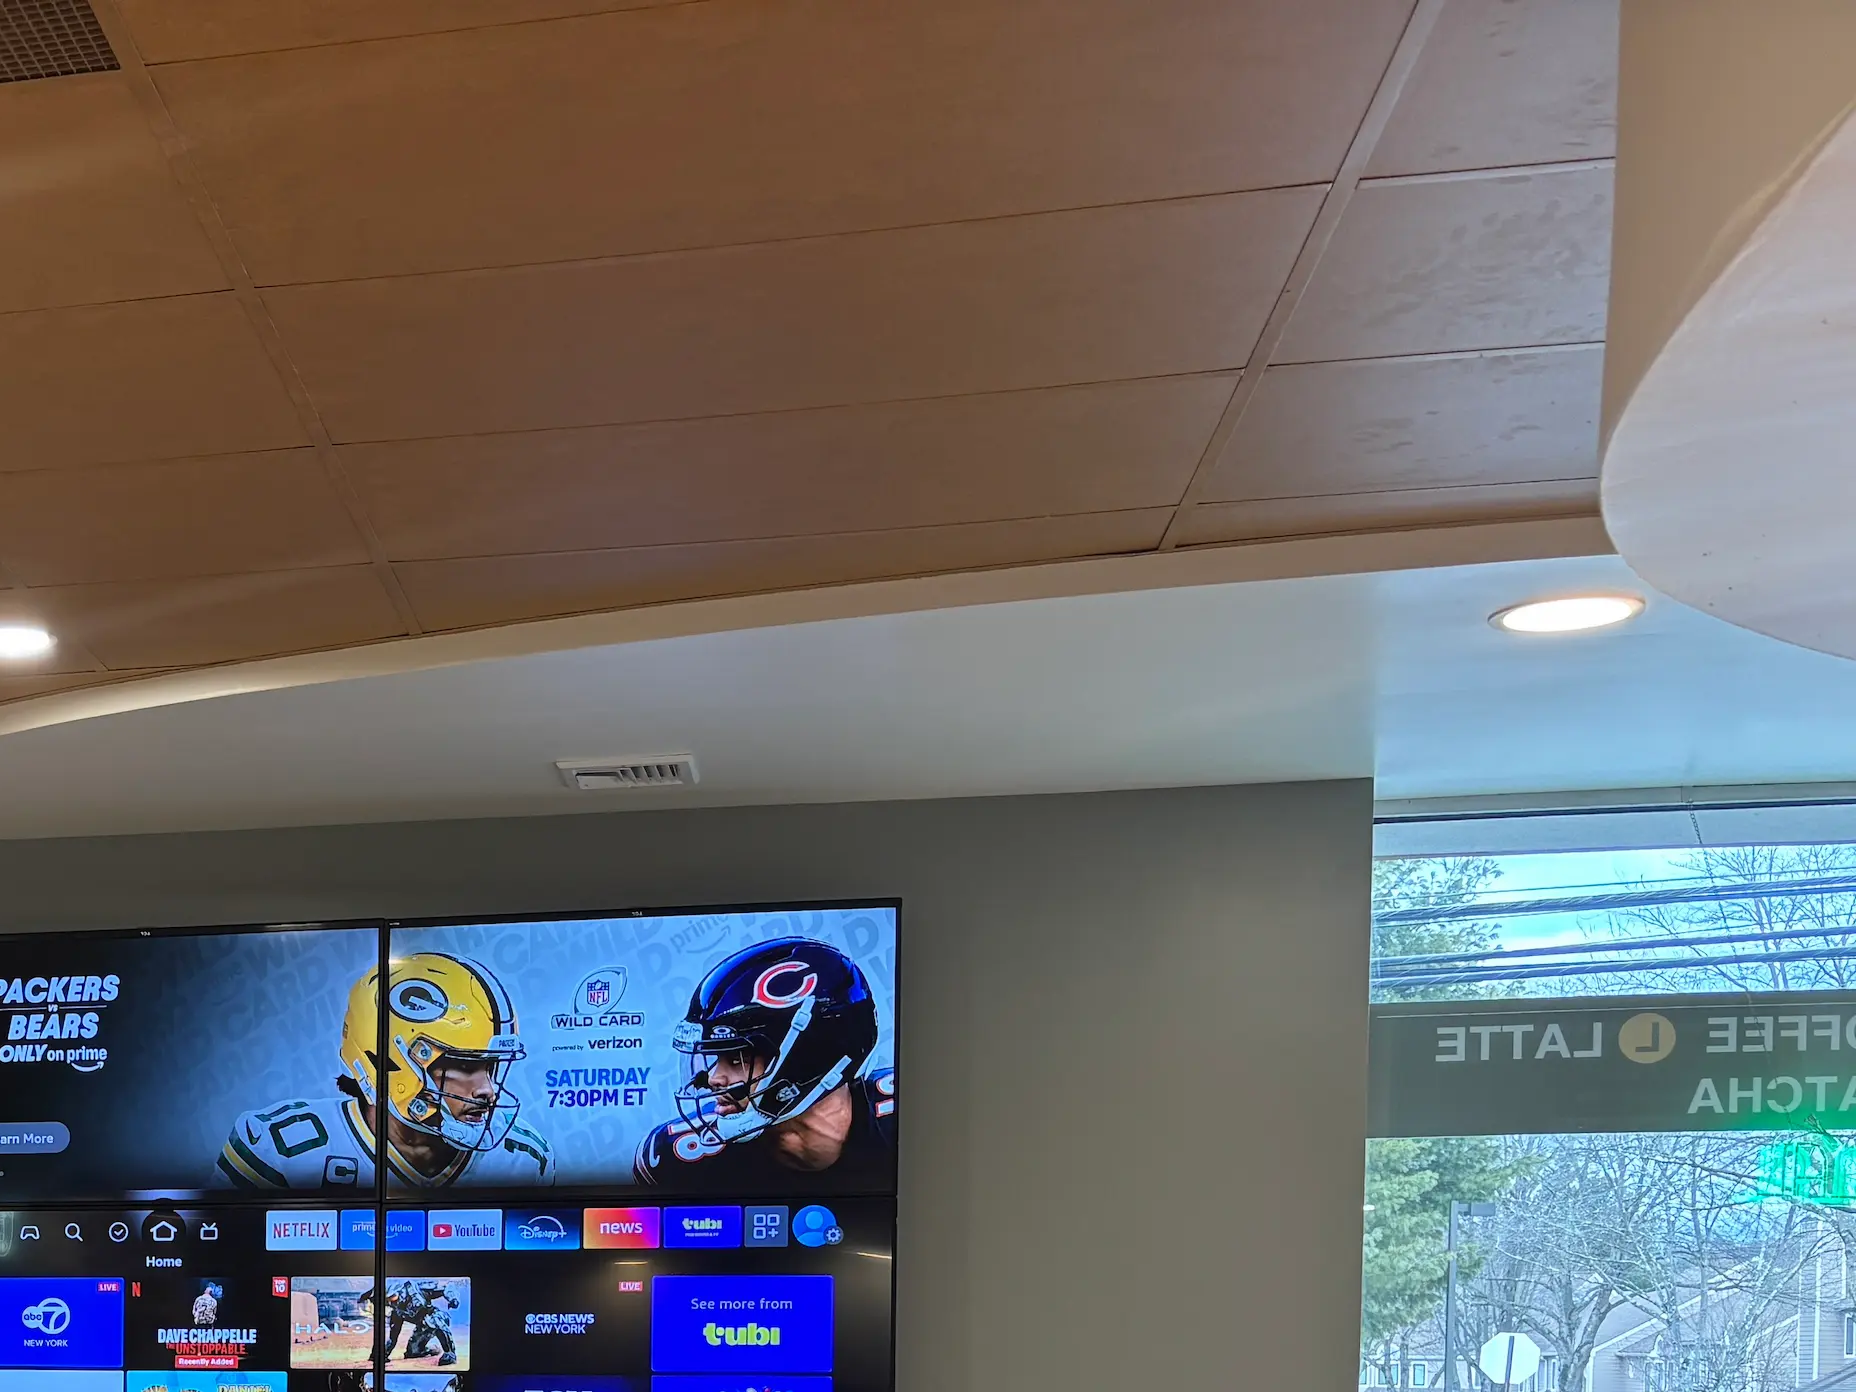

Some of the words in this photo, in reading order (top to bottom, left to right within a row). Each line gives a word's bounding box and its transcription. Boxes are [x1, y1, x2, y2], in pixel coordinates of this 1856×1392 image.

[589, 991, 608, 1004] NFL
[7, 1012, 100, 1040] BEARS
[555, 1016, 593, 1027] WILD
[598, 1015, 642, 1026] CARD
[587, 1036, 643, 1050] verizon
[47, 1050, 65, 1061] on
[66, 1046, 108, 1064] prime
[545, 1067, 651, 1087] SATURDAY
[547, 1088, 619, 1108] 7:30PM
[623, 1088, 648, 1105] ET
[23, 1133, 54, 1144] More
[390, 1223, 413, 1233] video
[454, 1223, 496, 1237] YouTube
[599, 1221, 644, 1234] news
[681, 1218, 723, 1230] tubi
[273, 1222, 330, 1239] NETFLIX
[146, 1255, 183, 1268] Home
[99, 1283, 117, 1292] LIVE
[275, 1284, 286, 1292] 10
[620, 1282, 641, 1291] LIVE
[691, 1298, 715, 1310] See
[719, 1300, 755, 1310] more
[759, 1297, 793, 1310] from
[23, 1313, 42, 1321] abc
[535, 1313, 558, 1324] CBS
[559, 1313, 594, 1324] NEWS
[295, 1322, 372, 1334] HALO
[525, 1324, 553, 1334] NEW
[553, 1324, 586, 1334] YORK
[702, 1322, 781, 1346] tubi
[157, 1328, 188, 1343] DAVE
[189, 1328, 257, 1343] CHAPPELLE
[24, 1339, 43, 1347] NEW
[45, 1339, 68, 1347] YORK
[176, 1342, 247, 1354] UNSTOPPABLE
[178, 1357, 210, 1367] Recently
[211, 1357, 234, 1365] Added
